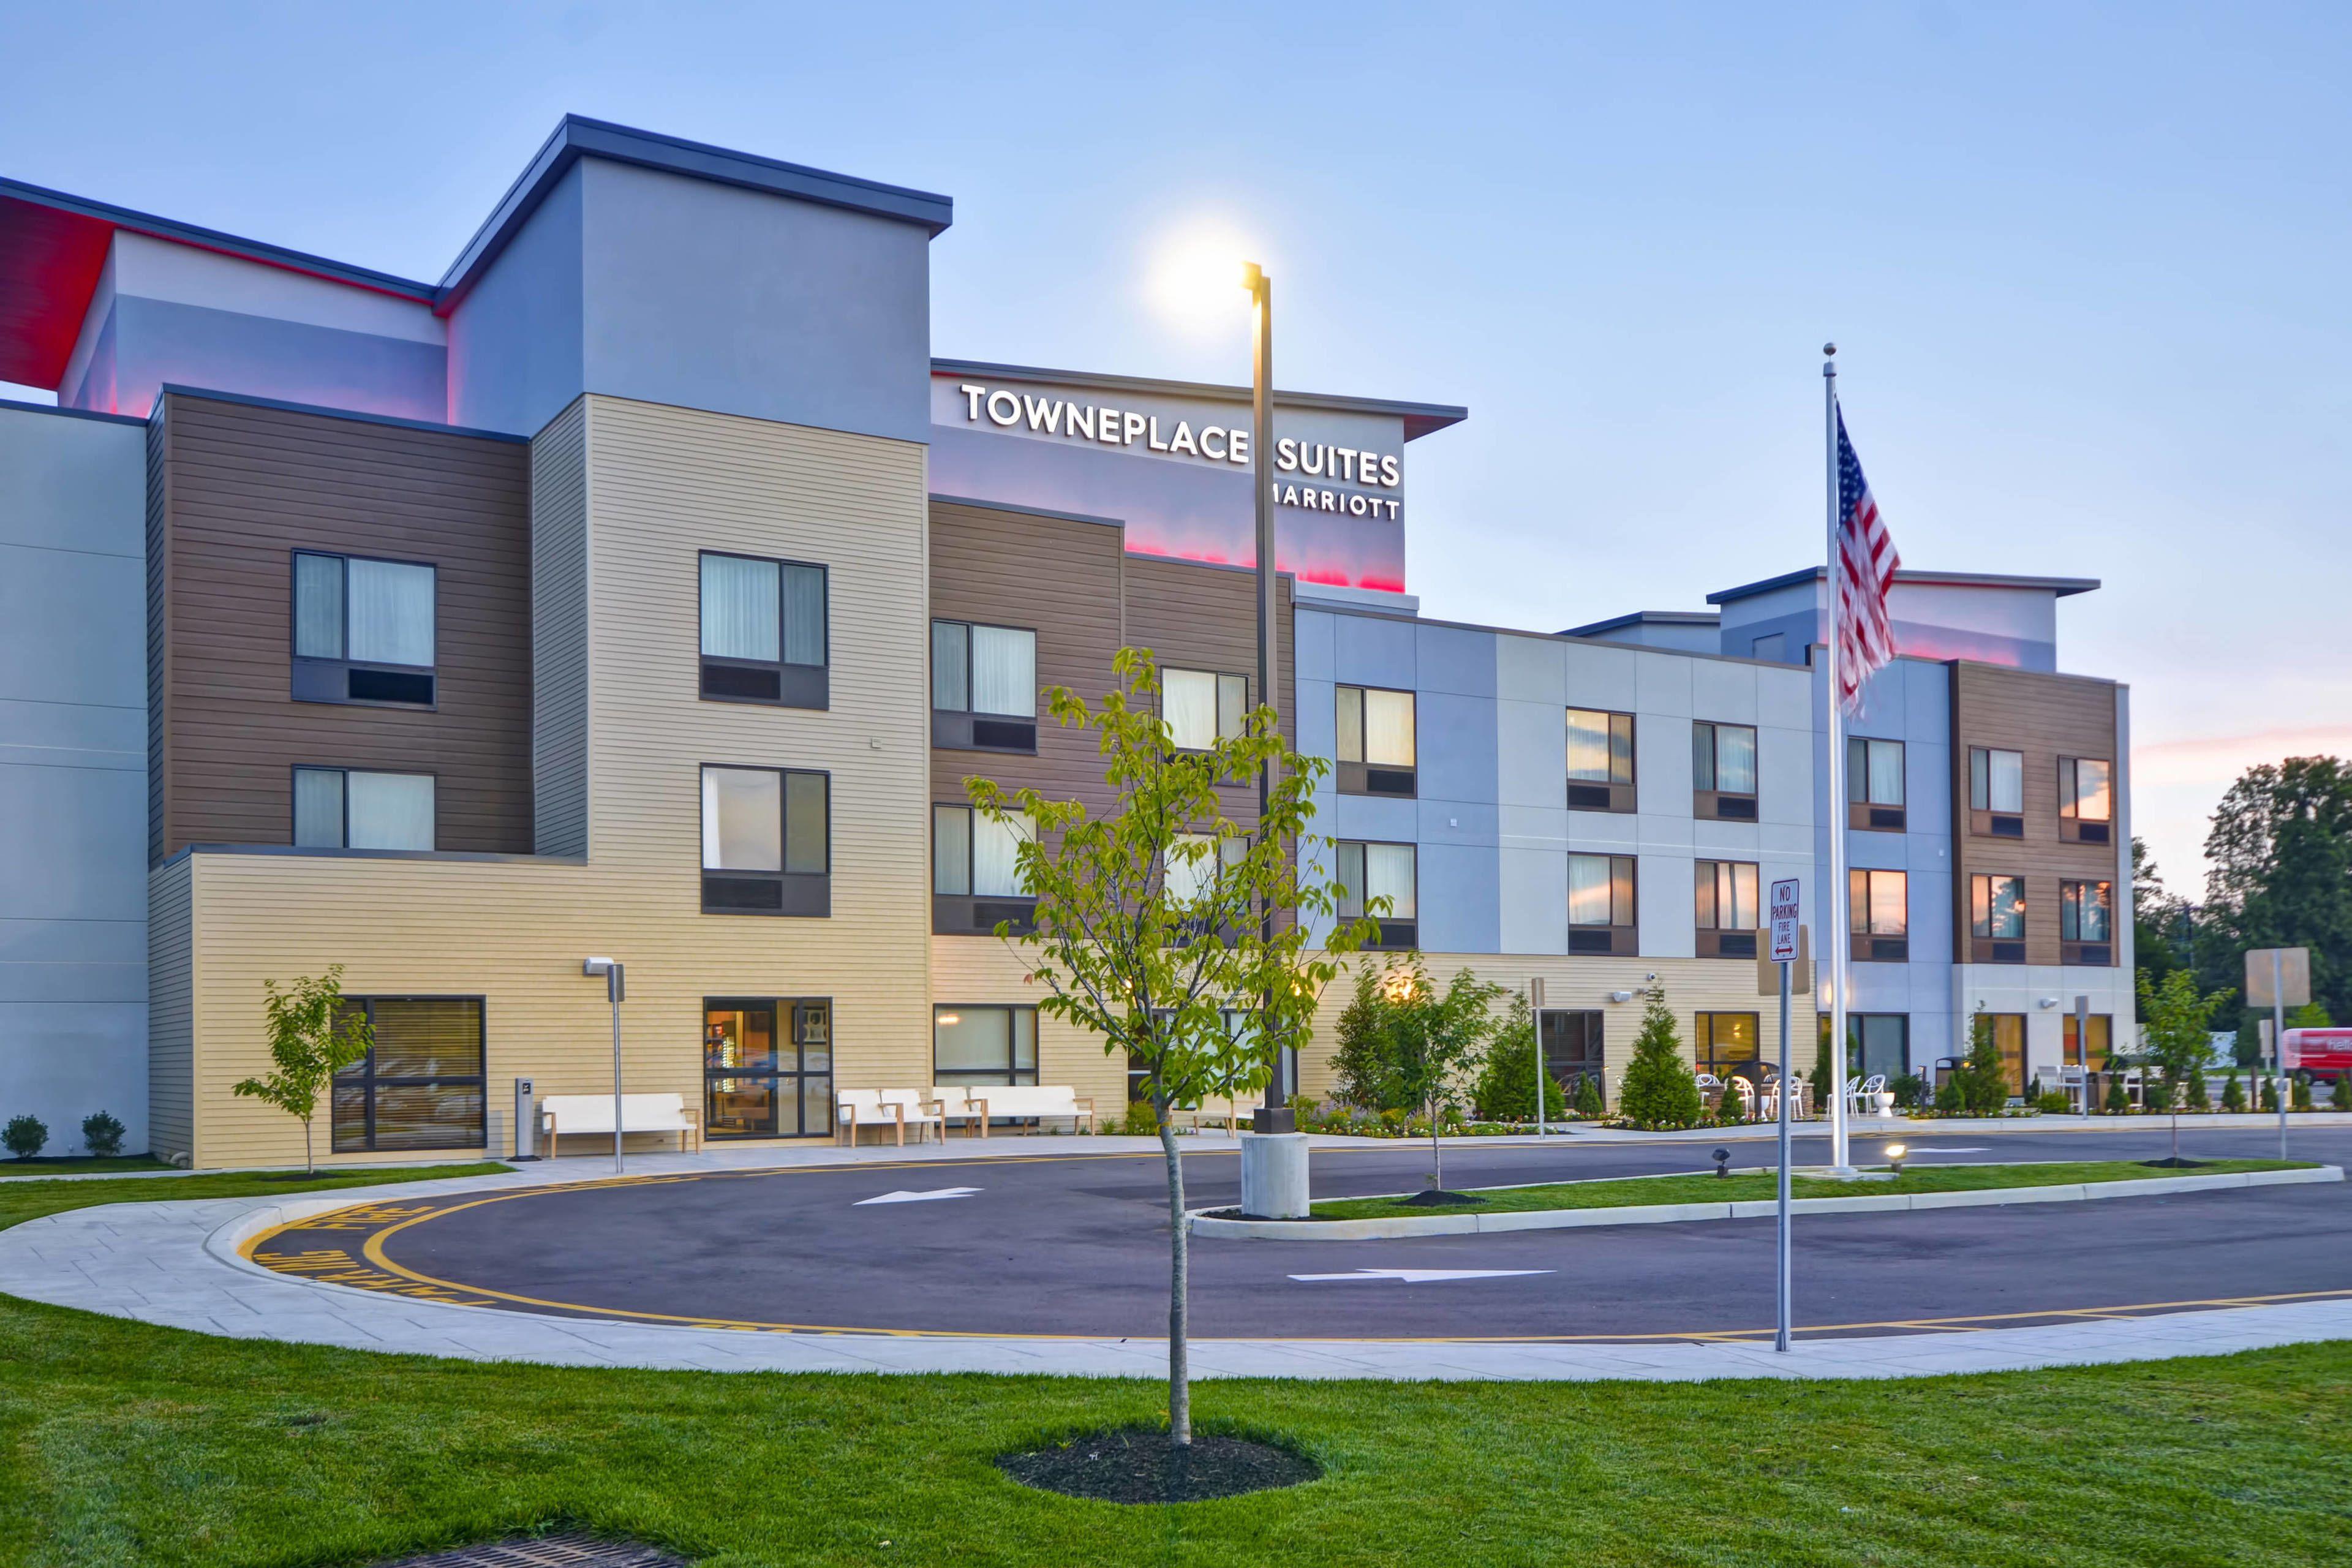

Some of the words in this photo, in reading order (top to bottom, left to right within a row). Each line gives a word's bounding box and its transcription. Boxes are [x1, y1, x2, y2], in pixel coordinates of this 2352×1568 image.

[960, 384, 1249, 464] TOWNEPLACE
[1276, 438, 1400, 487] SUITES
[1779, 886, 1791, 902] NO
[1773, 903, 1797, 921] PARKING
[1779, 922, 1790, 932] FIRE
[1777, 933, 1790, 944] LANE
